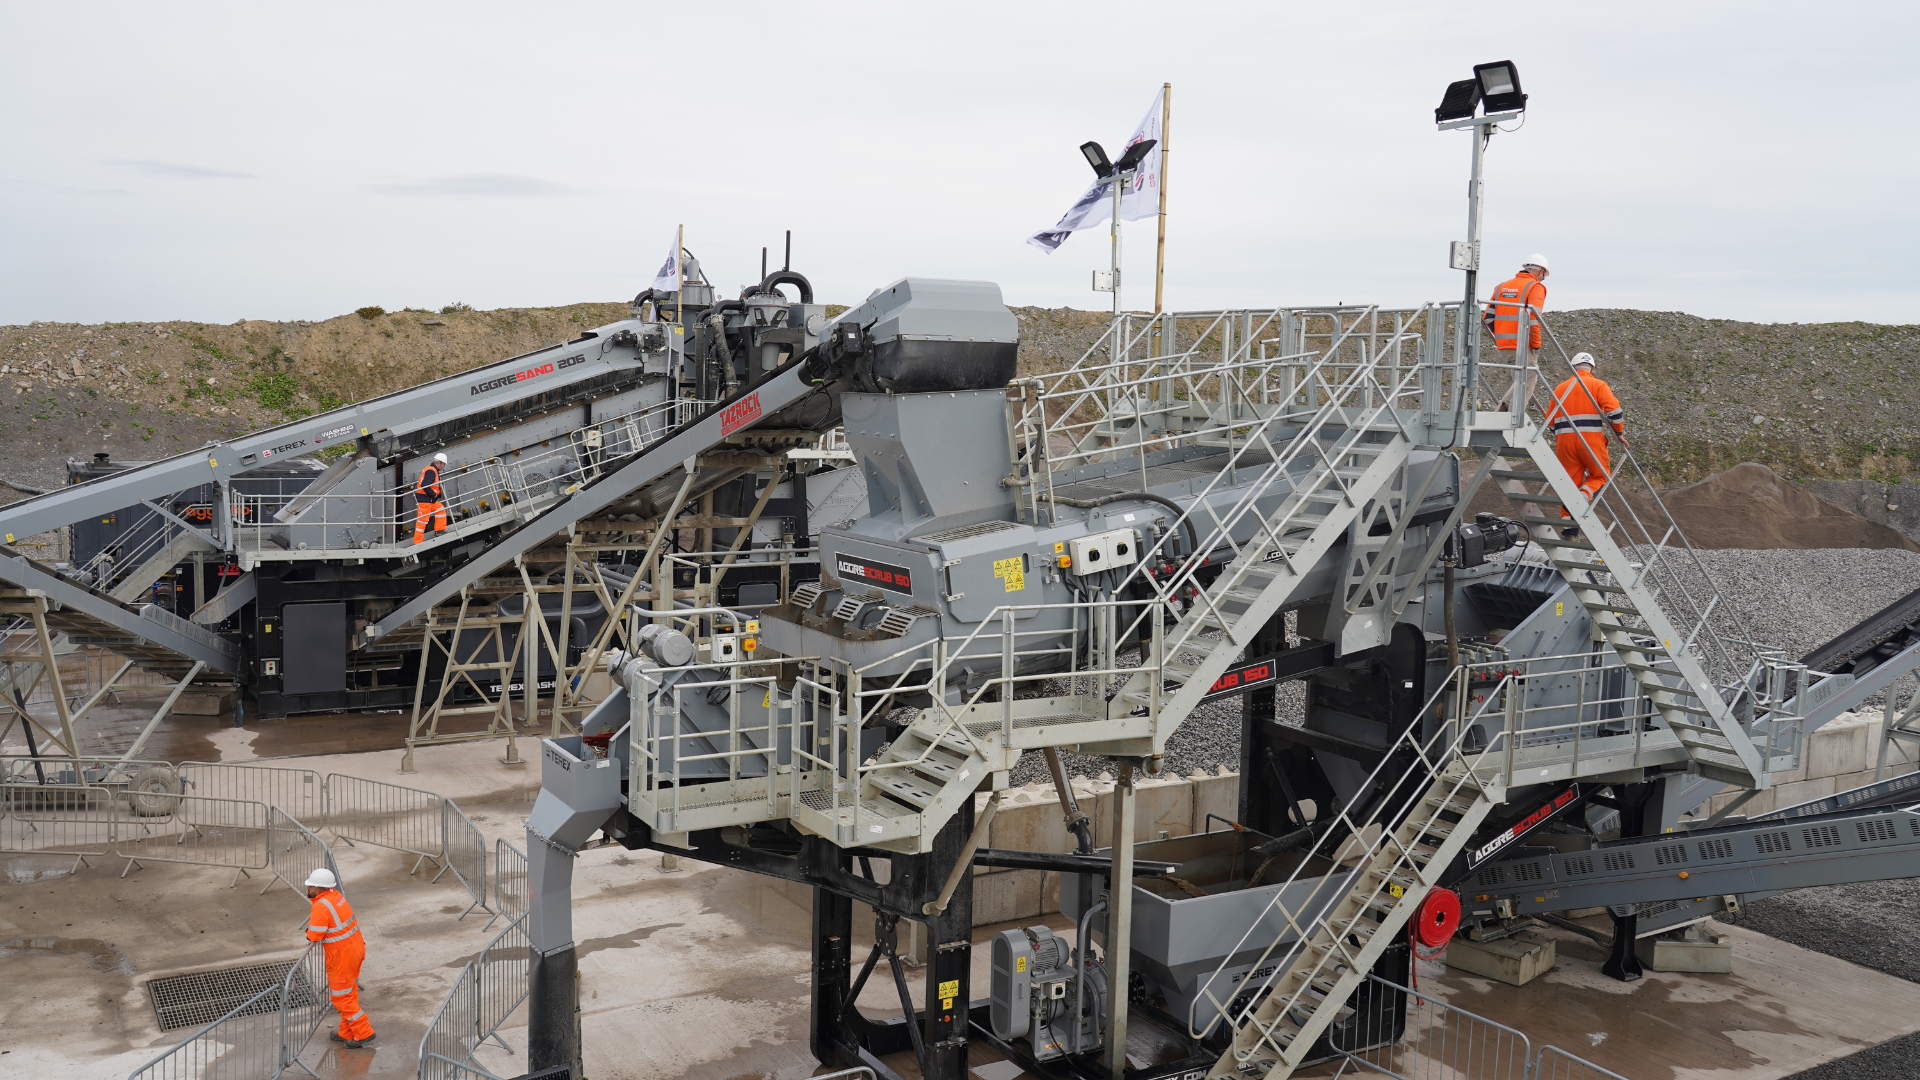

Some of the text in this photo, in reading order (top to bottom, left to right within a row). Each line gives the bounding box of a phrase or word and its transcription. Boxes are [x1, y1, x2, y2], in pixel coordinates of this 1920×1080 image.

[471, 354, 586, 396] AGGRESAND 206
[719, 391, 761, 427] TAZROCK
[271, 440, 307, 454] TEREX
[838, 560, 910, 588] AGGRESCRUB 150
[1242, 665, 1269, 682] 150
[550, 748, 572, 774] TEREX
[1475, 789, 1574, 862] AGGRESCRUB 150
